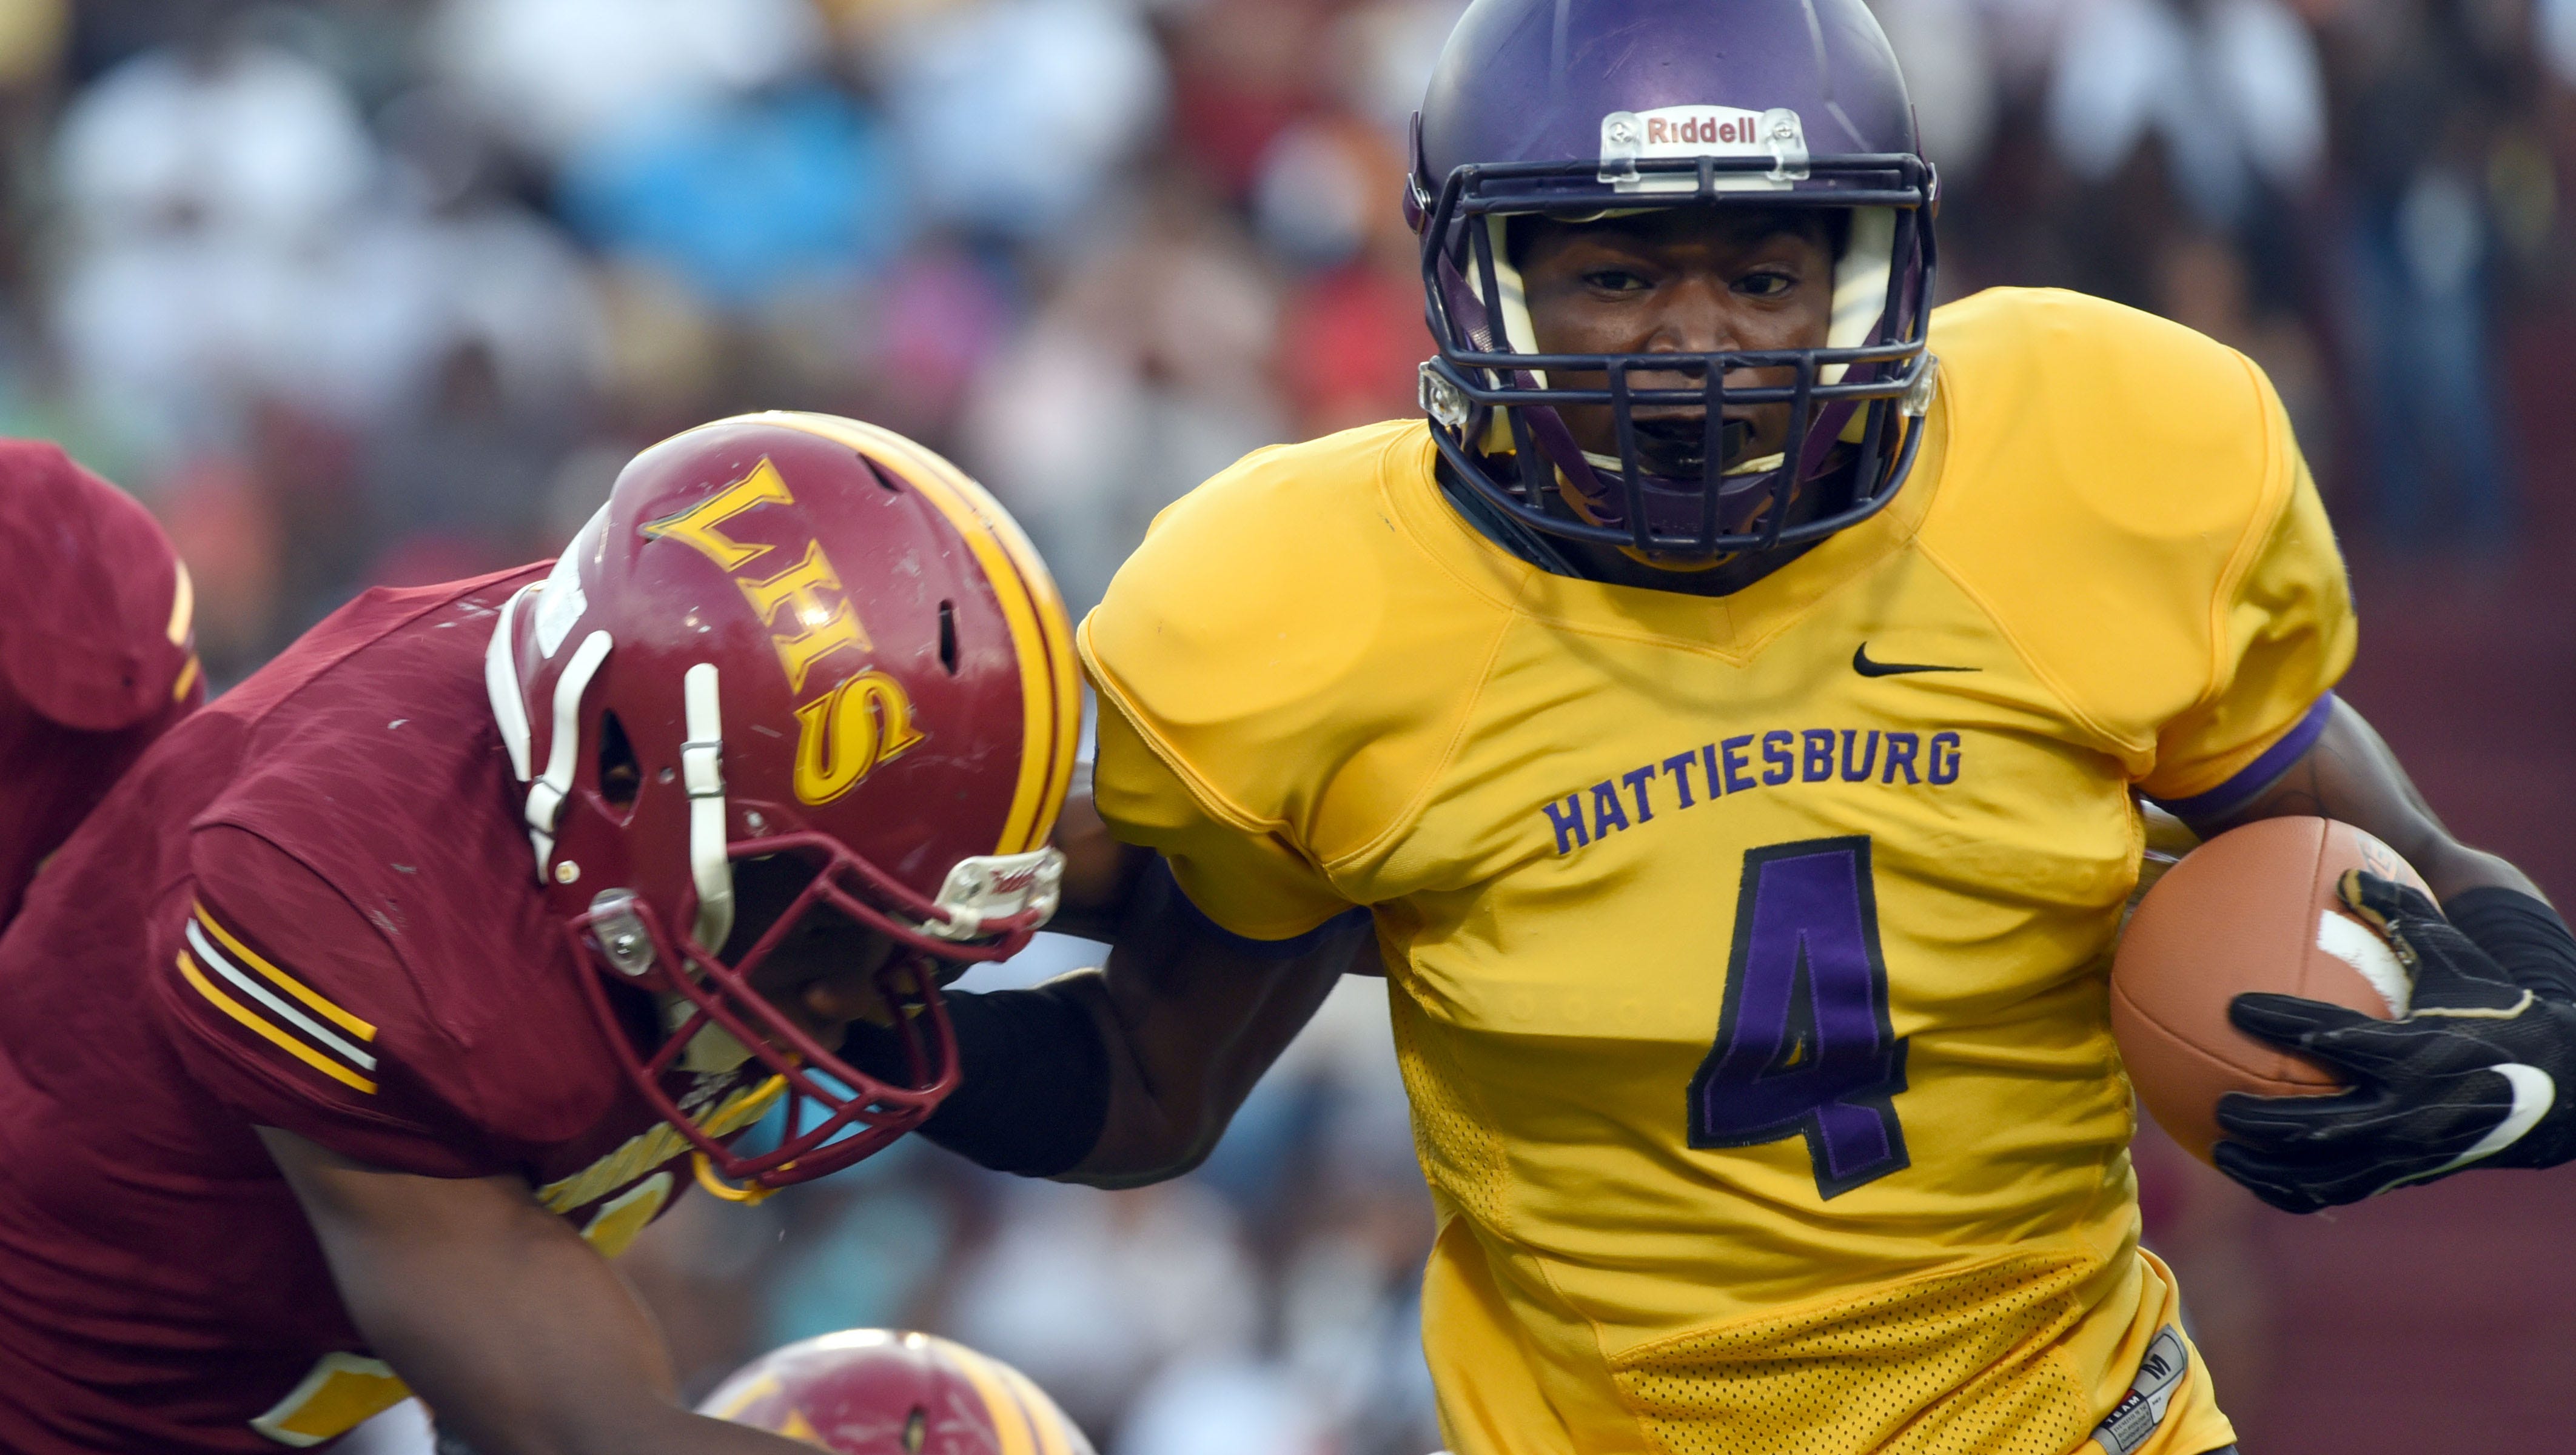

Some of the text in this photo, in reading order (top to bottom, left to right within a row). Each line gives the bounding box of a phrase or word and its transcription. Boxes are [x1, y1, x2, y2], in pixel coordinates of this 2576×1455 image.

[1648, 117, 1756, 144] Riddell
[639, 456, 925, 806] LHS
[1541, 729, 1962, 855] HATTIESBURG
[1686, 834, 1911, 1202] 4
[2141, 1353, 2171, 1380] M
[2105, 1395, 2140, 1423] TEAM
